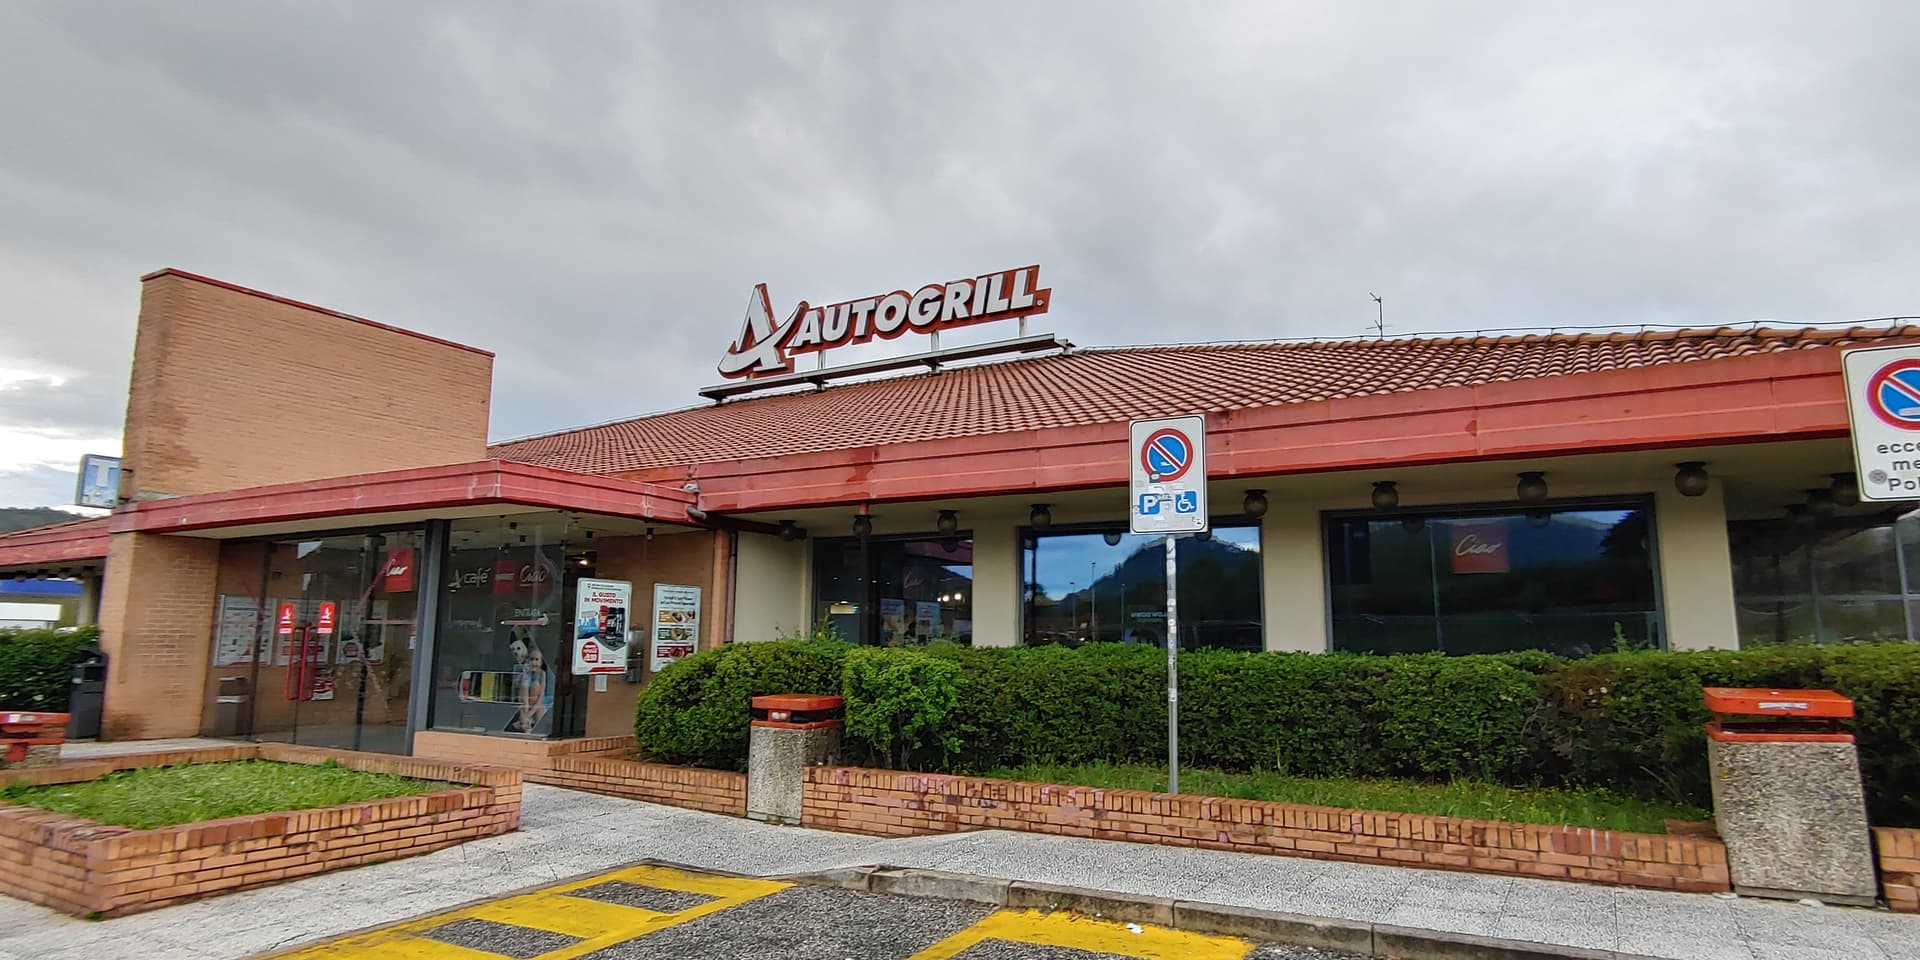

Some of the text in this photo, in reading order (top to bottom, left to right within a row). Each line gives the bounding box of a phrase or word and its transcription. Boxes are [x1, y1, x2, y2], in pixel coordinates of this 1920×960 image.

[791, 269, 1037, 348] AUTOGRILL
[1143, 495, 1159, 513] P
[1456, 534, 1502, 556] Ciao
[464, 568, 491, 588] café
